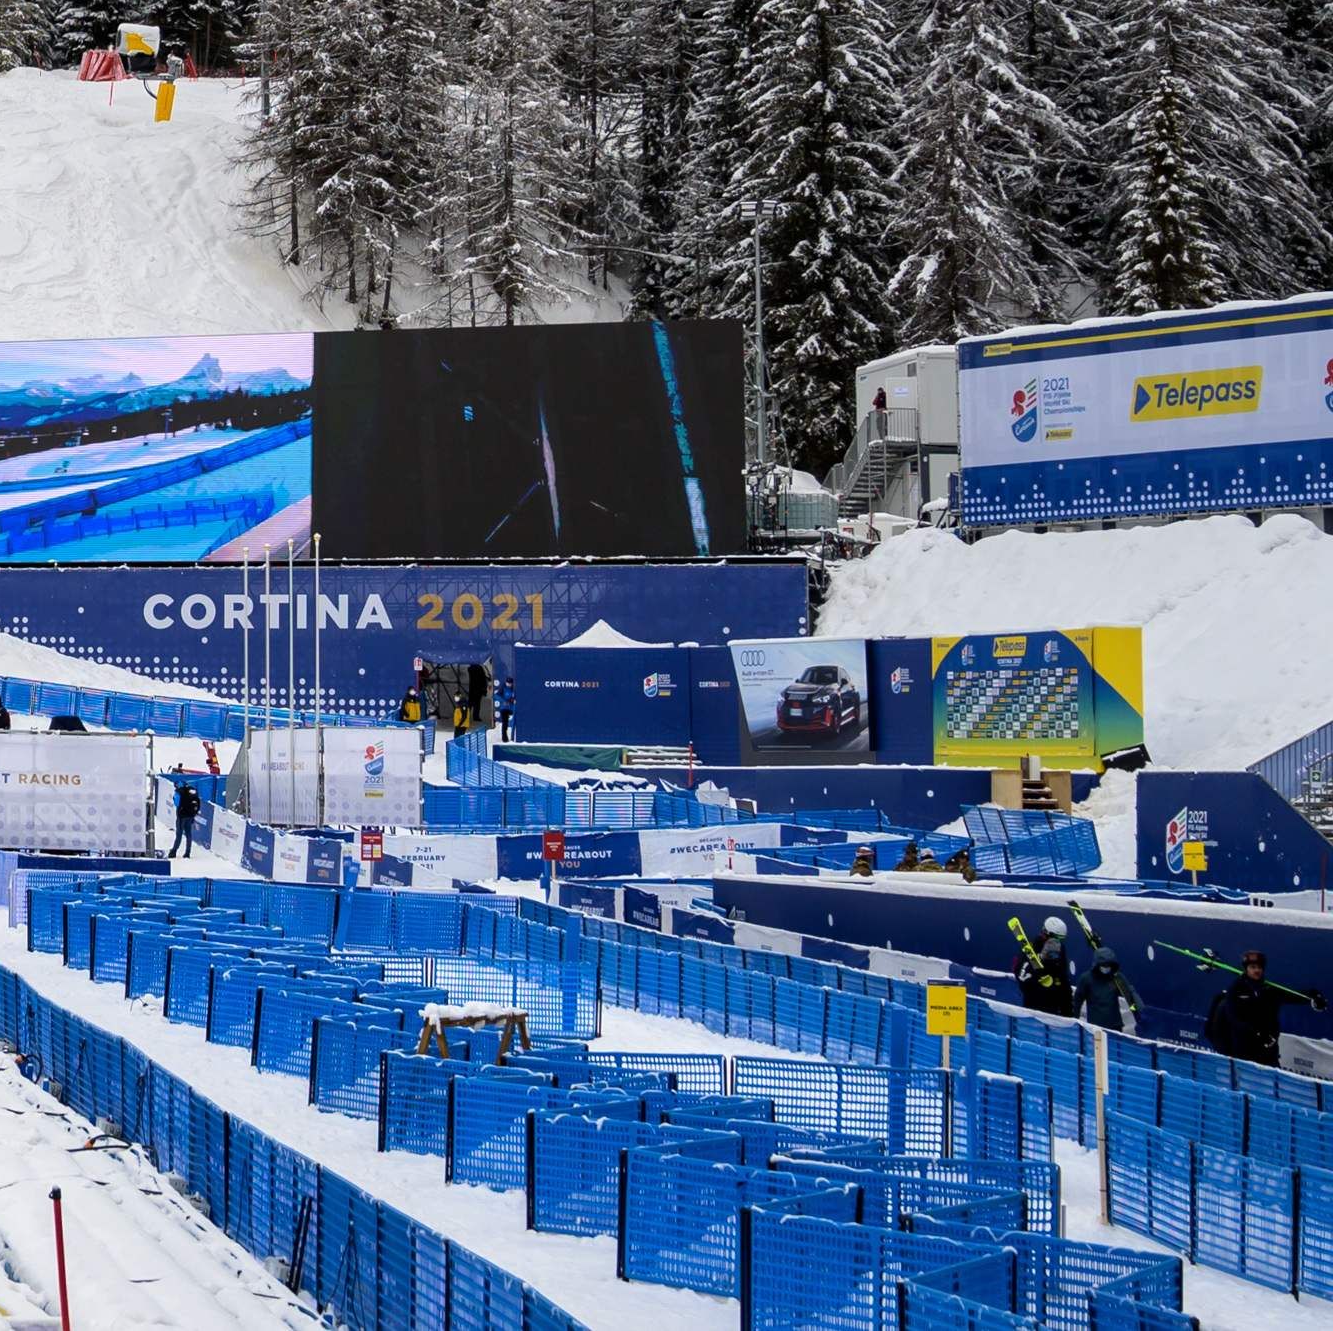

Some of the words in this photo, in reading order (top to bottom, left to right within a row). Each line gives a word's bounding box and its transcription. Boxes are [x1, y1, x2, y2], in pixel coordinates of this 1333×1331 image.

[1043, 378, 1070, 391] 2021
[1154, 378, 1256, 411] Telepass
[143, 593, 393, 630] CORTINA
[416, 593, 545, 630] 2021
[544, 680, 580, 688] CORTINA
[581, 680, 600, 688] 2021
[18, 773, 82, 786] RACING
[1188, 810, 1208, 823] 2021
